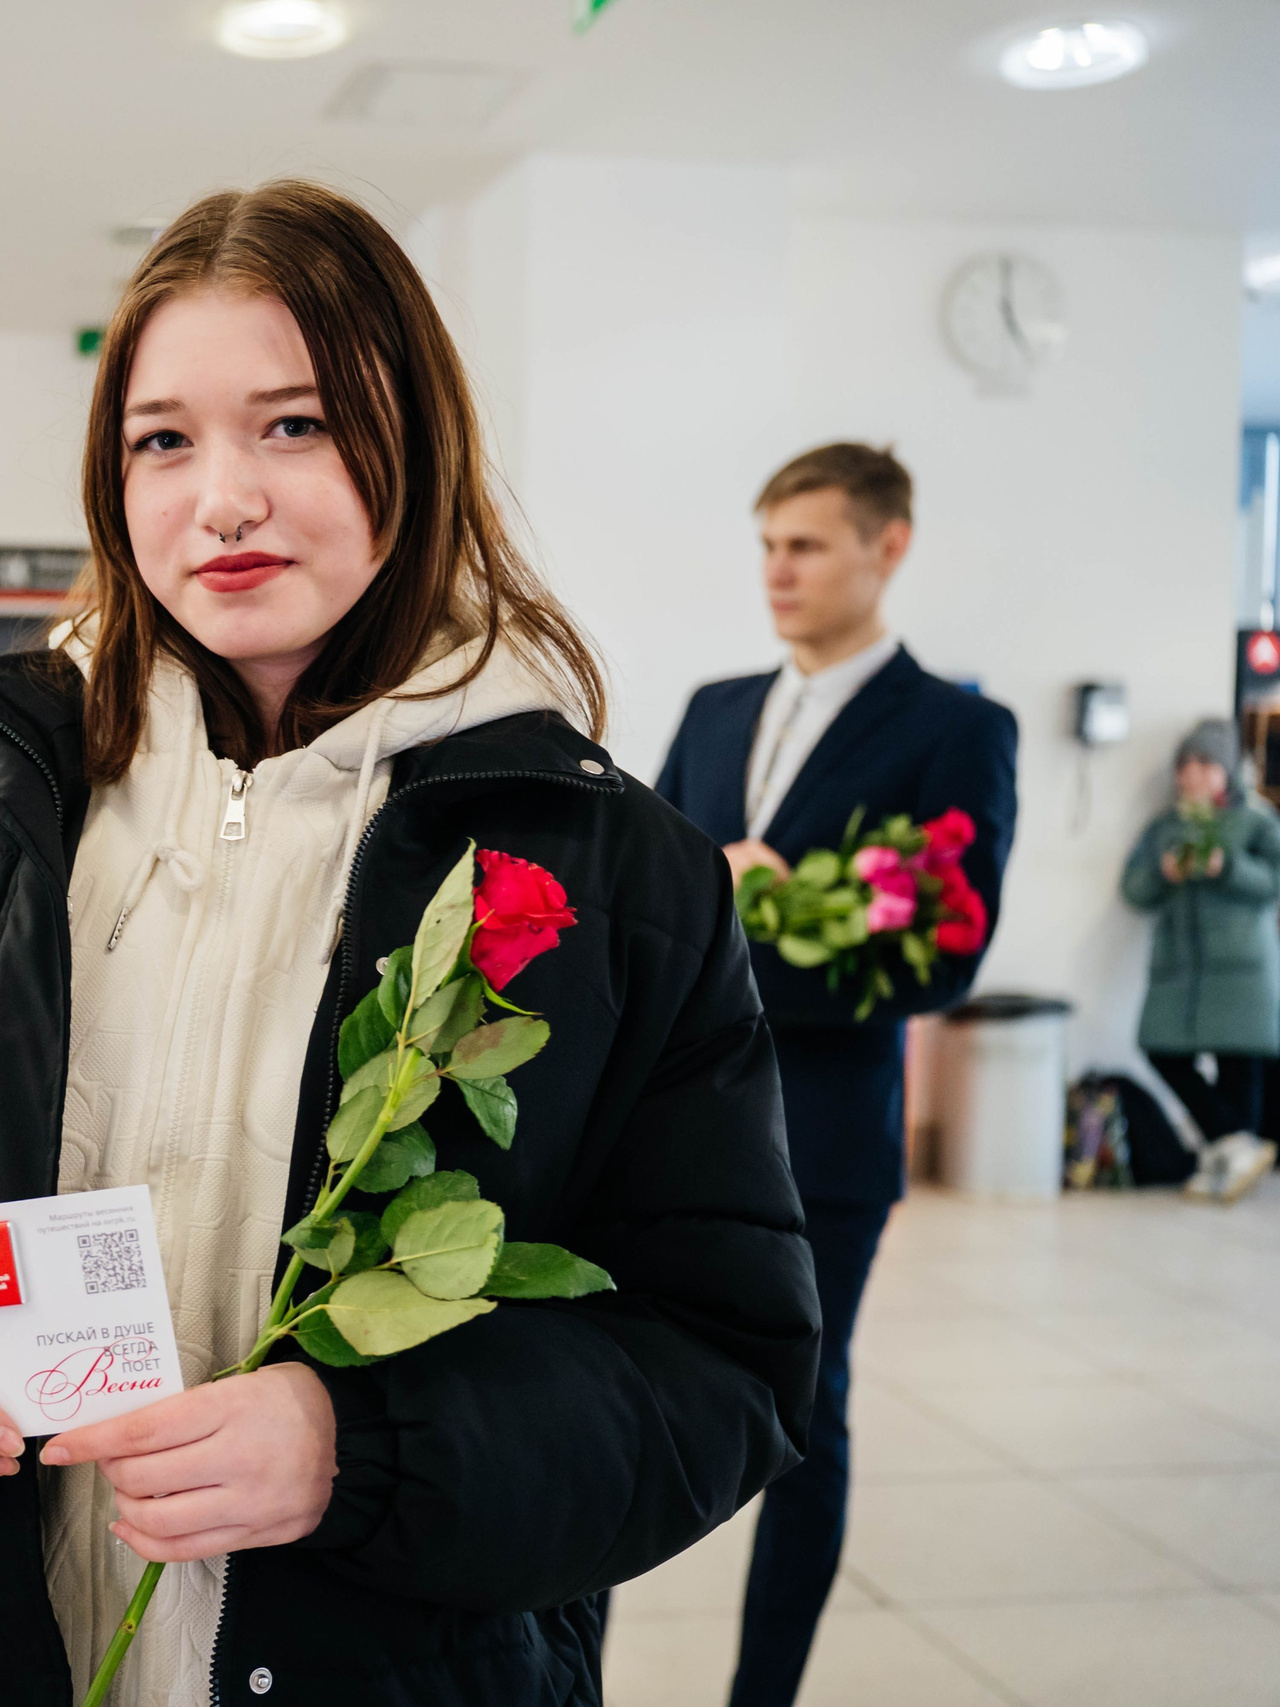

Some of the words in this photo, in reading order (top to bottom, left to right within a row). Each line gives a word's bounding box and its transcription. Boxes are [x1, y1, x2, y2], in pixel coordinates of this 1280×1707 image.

[49, 1211, 93, 1221] Маршруты
[37, 1221, 90, 1235] путешествий
[36, 1326, 97, 1347] ПУСКАЙ
[101, 1327, 110, 1339] В
[114, 1321, 155, 1340] ДУШЕ
[103, 1340, 159, 1357] ВСЕГДА
[122, 1358, 160, 1373] ПОЕТ
